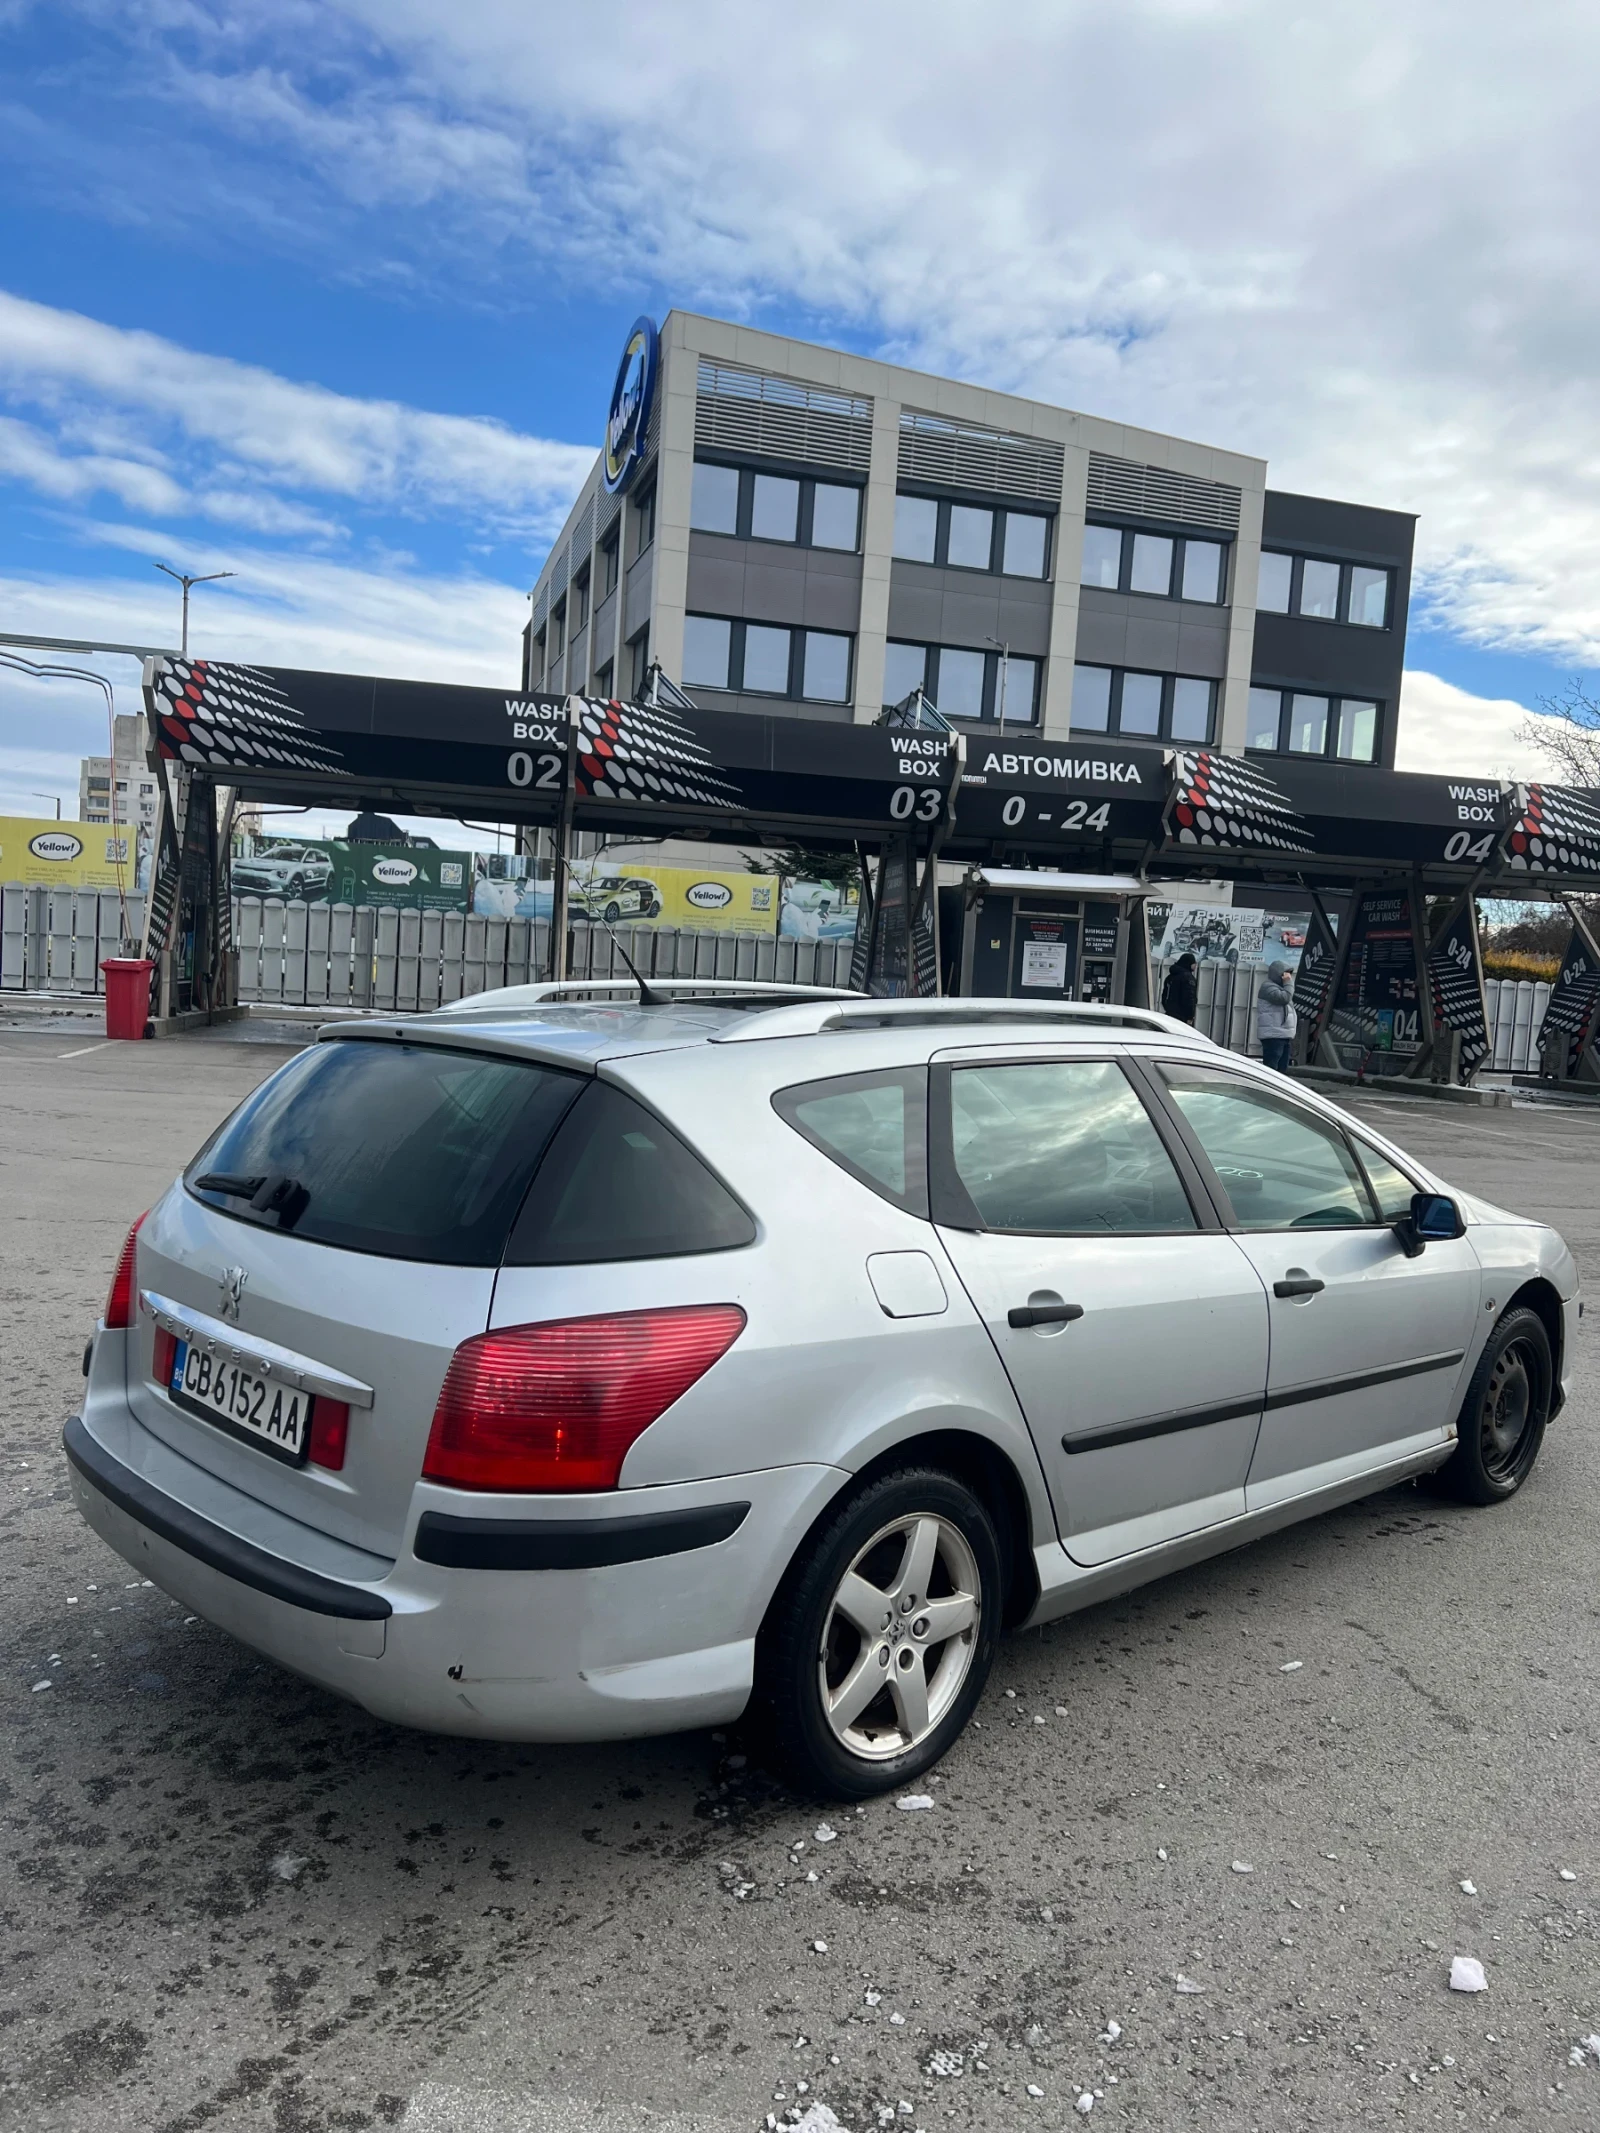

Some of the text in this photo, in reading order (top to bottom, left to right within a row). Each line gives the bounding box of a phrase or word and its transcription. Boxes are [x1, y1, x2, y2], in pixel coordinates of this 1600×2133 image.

[505, 700, 566, 721] WASH
[513, 722, 558, 742] BOX
[890, 737, 948, 757] WASH
[507, 751, 562, 789] 02
[899, 759, 940, 777] BOX
[983, 753, 1142, 783] АВТОМИВКА
[890, 786, 942, 822] 03
[1448, 785, 1500, 803] WASH
[1002, 796, 1026, 826] 0
[1060, 800, 1111, 832] 24
[1457, 805, 1495, 822] BOX
[37, 841, 75, 852] Yellow!
[1443, 831, 1496, 863] 04
[378, 867, 413, 877] Yellow!
[693, 891, 726, 900] Yellow!
[1363, 899, 1401, 911] SELF SERVICE
[1368, 910, 1400, 922] CAR WASH
[1304, 941, 1324, 970] 0-24
[1447, 937, 1472, 970] 0-24
[1563, 957, 1587, 985] 0-24
[1393, 1009, 1418, 1041] 04
[174, 1367, 183, 1382] BG
